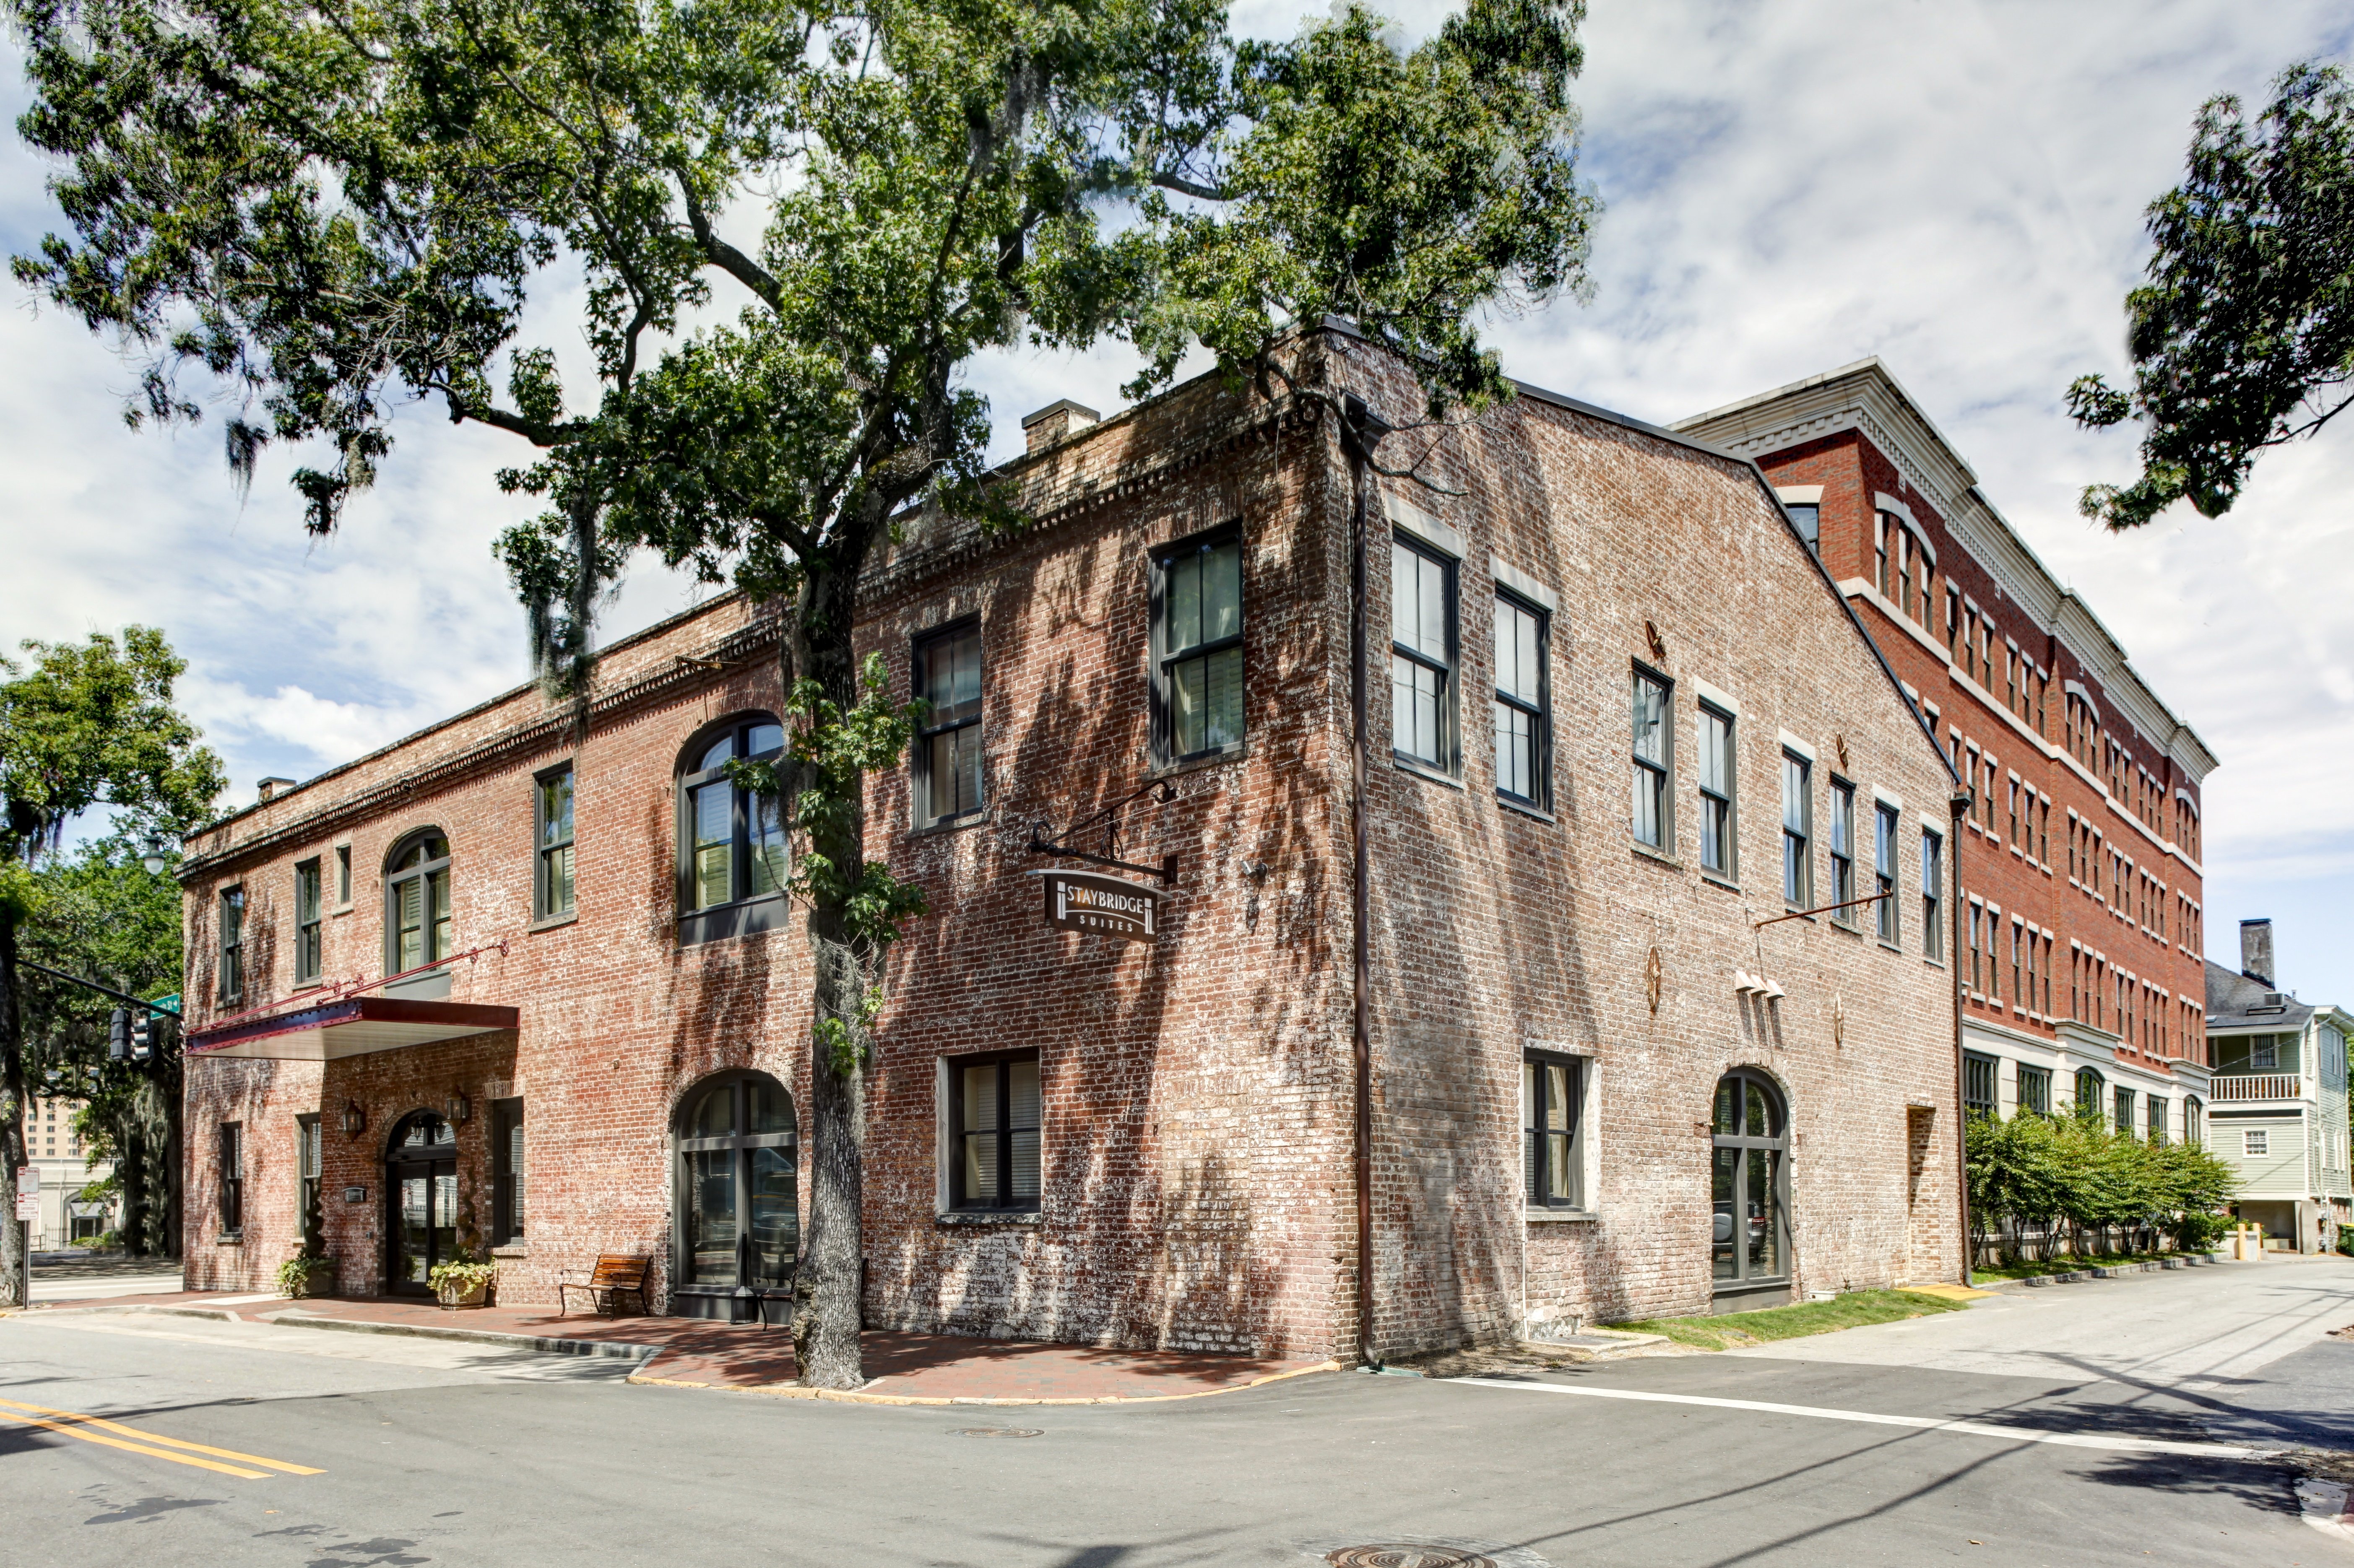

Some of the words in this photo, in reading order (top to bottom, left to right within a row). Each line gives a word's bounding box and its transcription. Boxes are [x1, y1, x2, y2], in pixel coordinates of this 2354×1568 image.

[1067, 885, 1144, 914] STAYBRIDGE
[1079, 915, 1133, 932] SUITES
[167, 1001, 172, 1010] St
